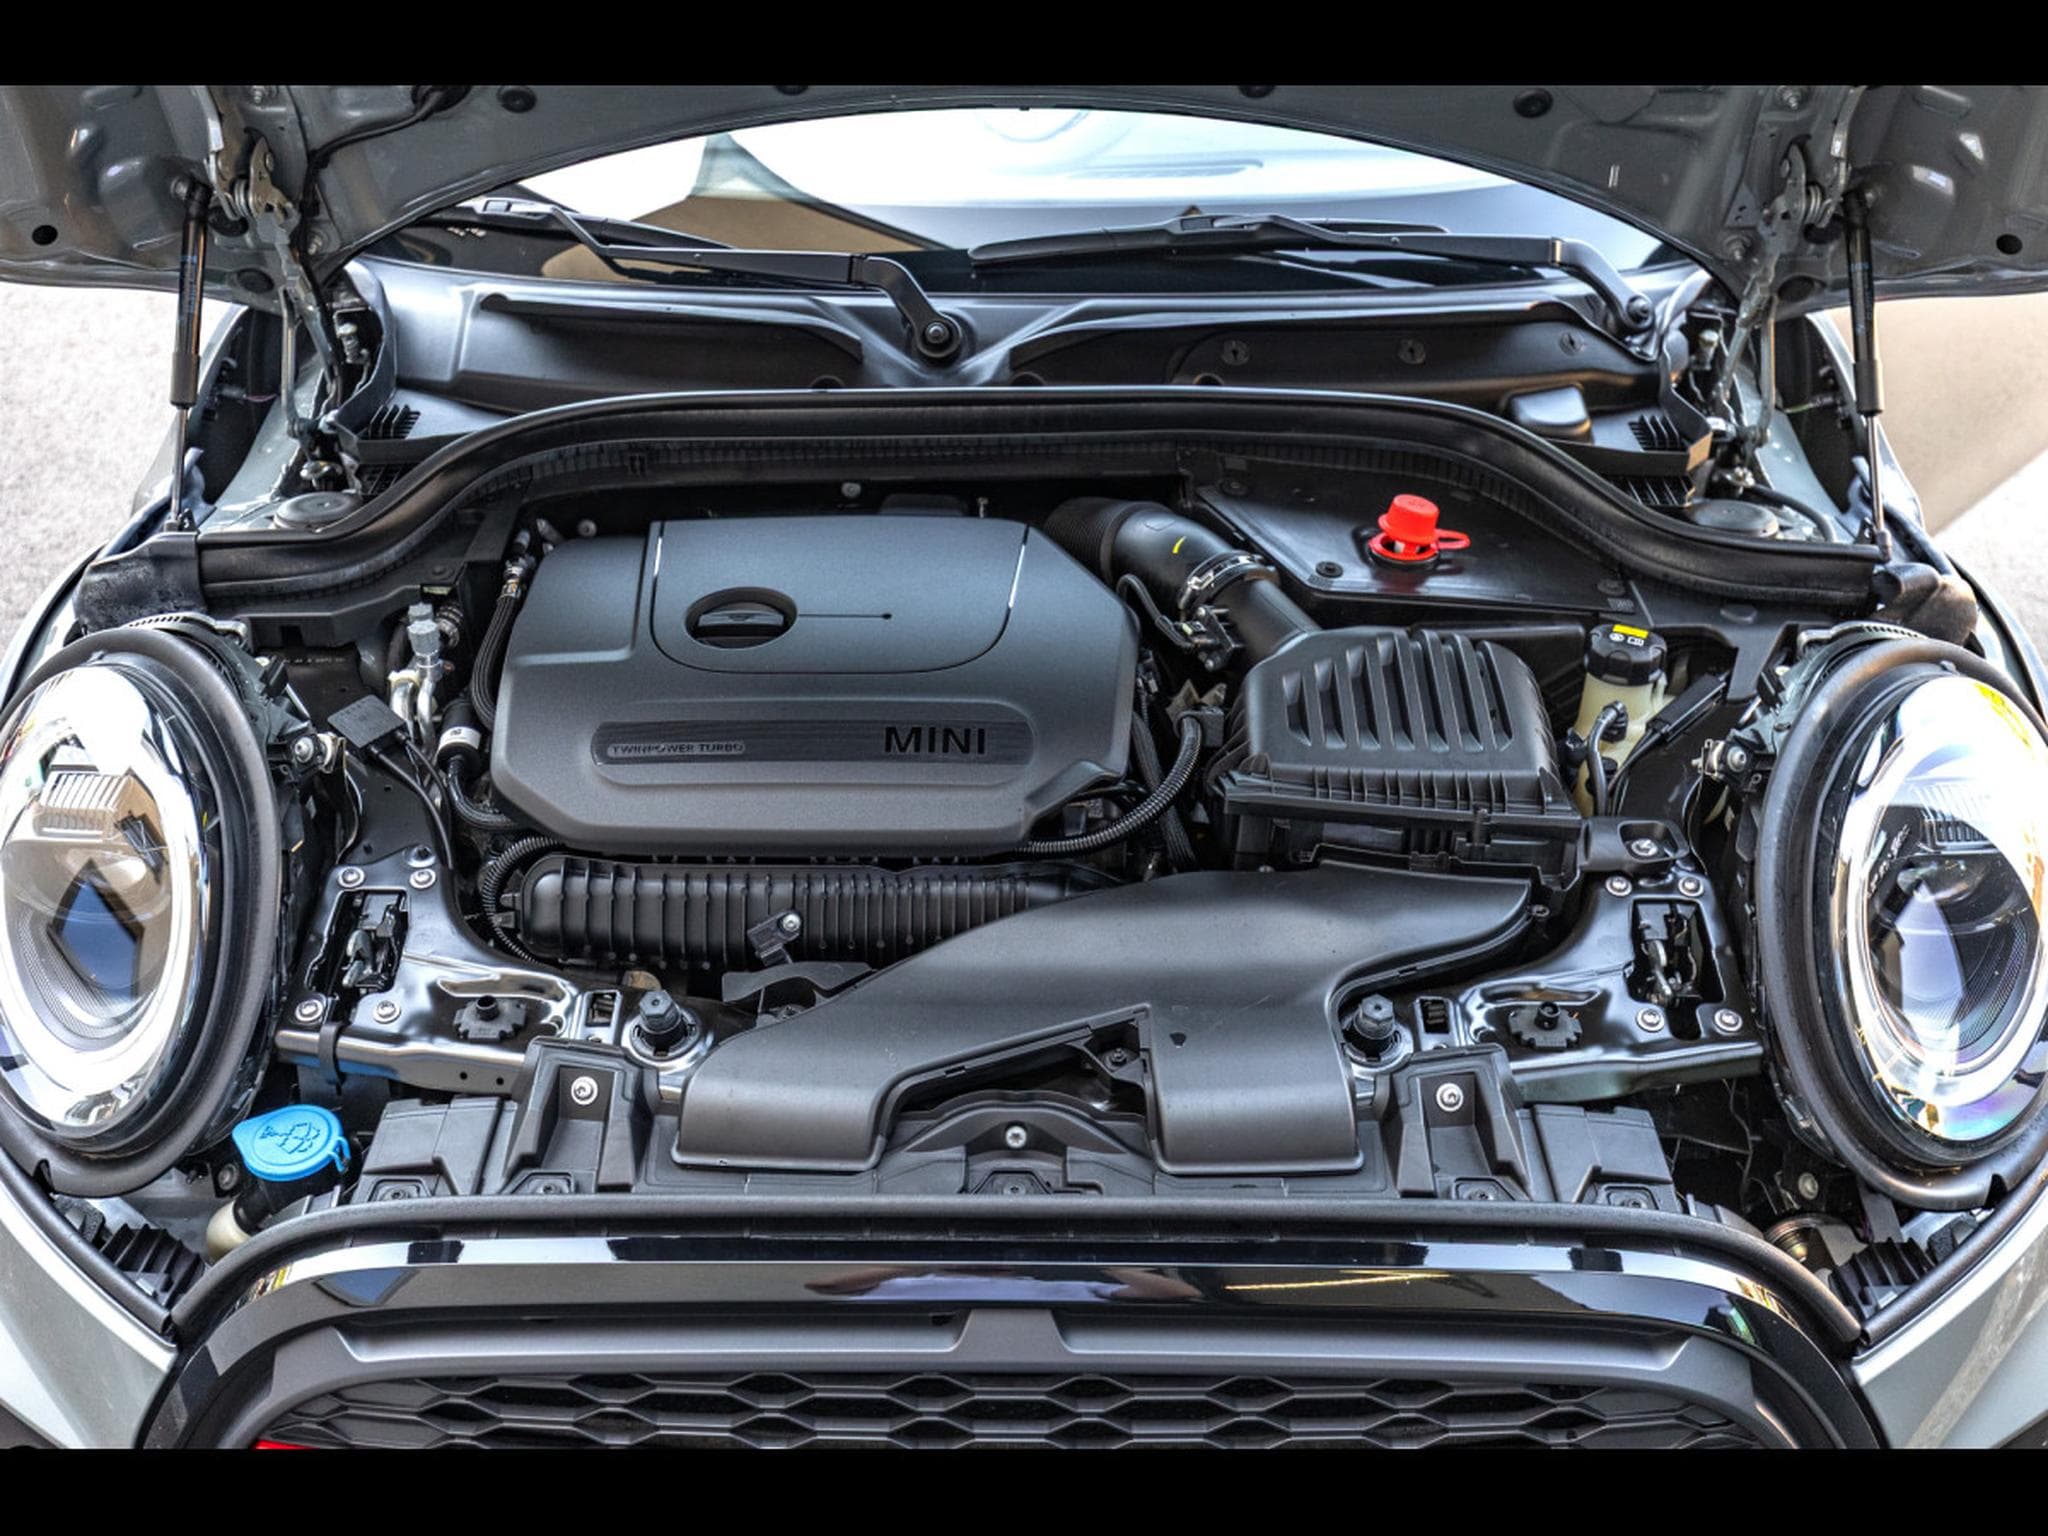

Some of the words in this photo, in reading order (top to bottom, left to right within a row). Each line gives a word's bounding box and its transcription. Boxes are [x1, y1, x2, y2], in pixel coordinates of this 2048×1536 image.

[612, 742, 695, 754] TWINPOWER
[700, 741, 744, 753] TURBO
[885, 727, 985, 754] MINI
